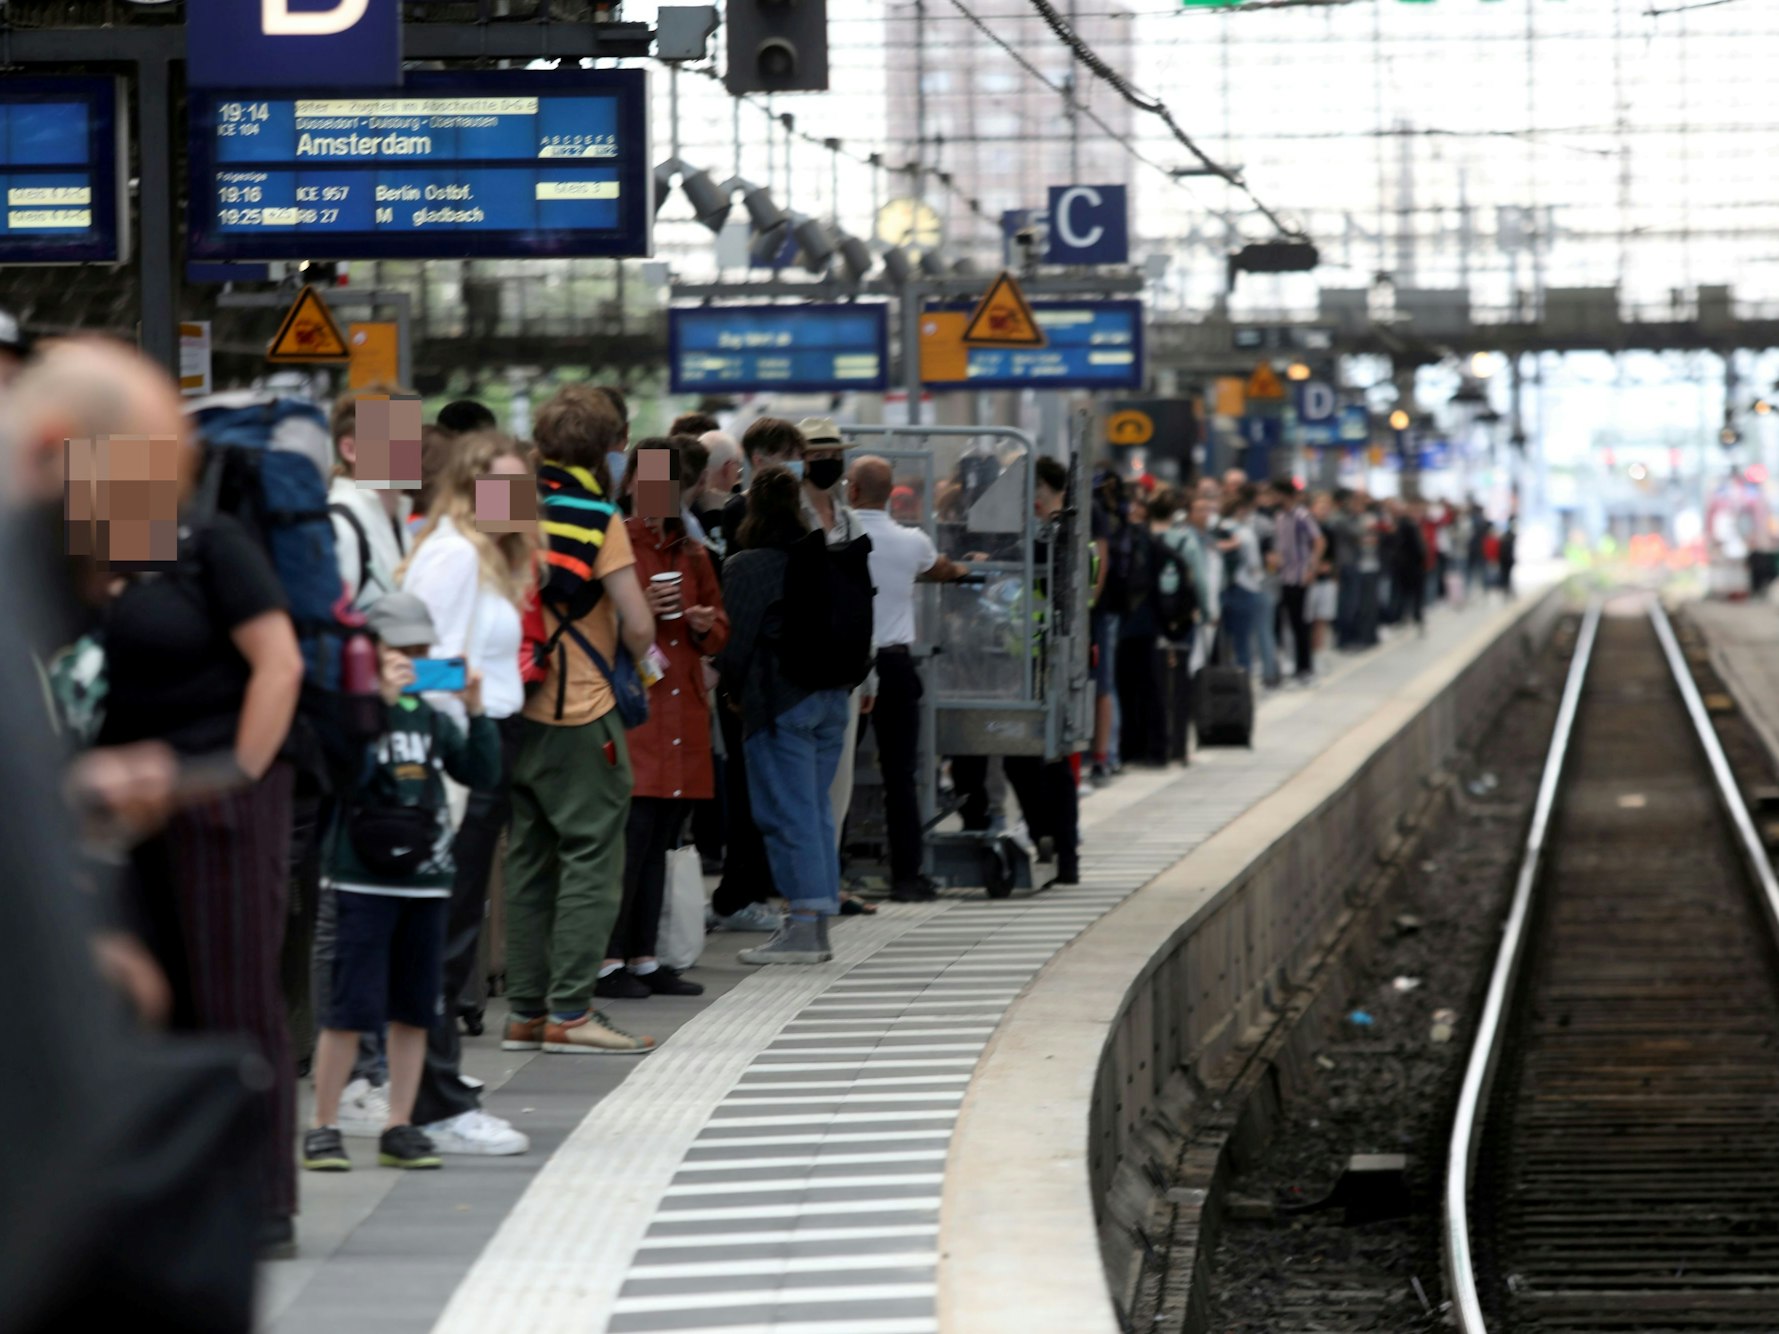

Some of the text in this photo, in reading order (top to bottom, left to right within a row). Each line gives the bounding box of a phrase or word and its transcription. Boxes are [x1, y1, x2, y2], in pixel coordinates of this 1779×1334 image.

[218, 102, 270, 122] 19:14
[296, 133, 432, 156] Amsterdam
[322, 186, 349, 201] 957
[375, 185, 420, 201] Berlin
[1056, 187, 1104, 248] C
[1303, 382, 1334, 420] D
